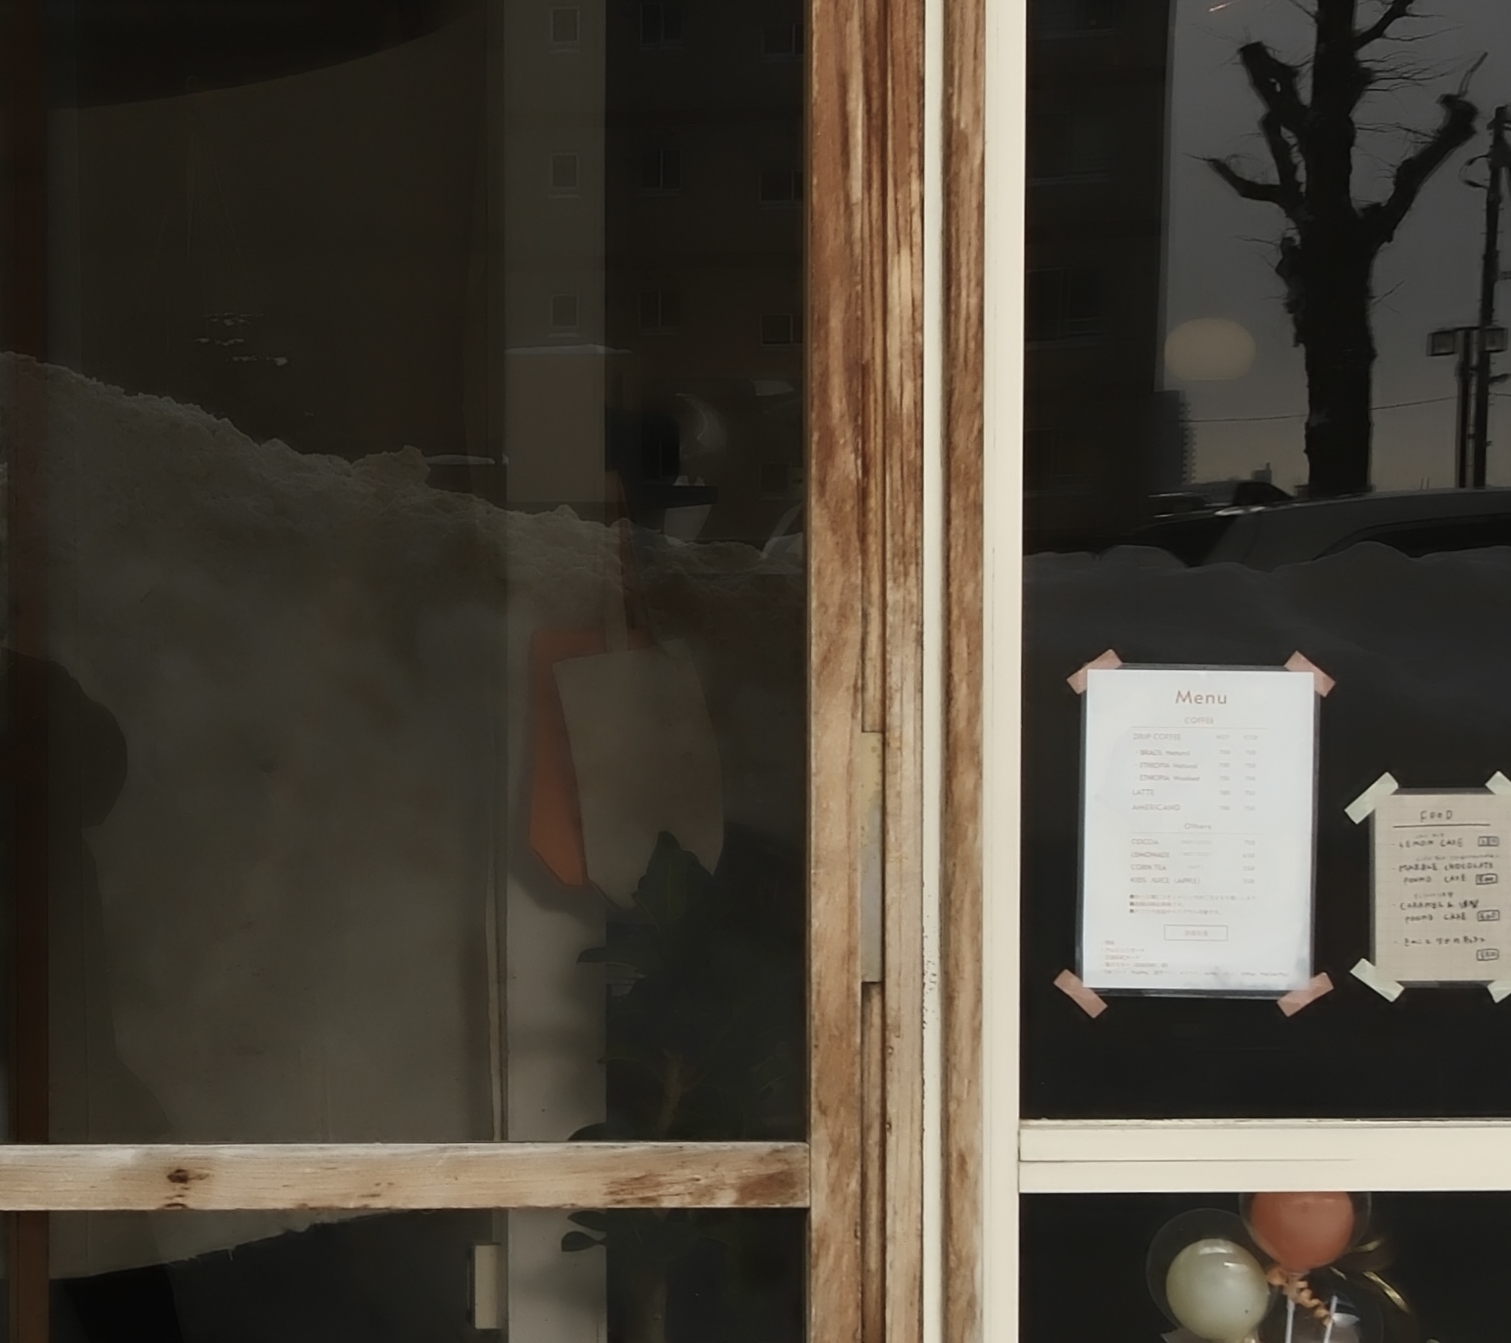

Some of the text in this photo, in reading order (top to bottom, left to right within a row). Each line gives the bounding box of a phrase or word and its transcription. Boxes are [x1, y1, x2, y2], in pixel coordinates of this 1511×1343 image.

[1174, 690, 1227, 705] Menu
[1184, 717, 1214, 725] COFFEE
[1153, 733, 1181, 741] COFFEE
[1419, 809, 1454, 822] FOOD
